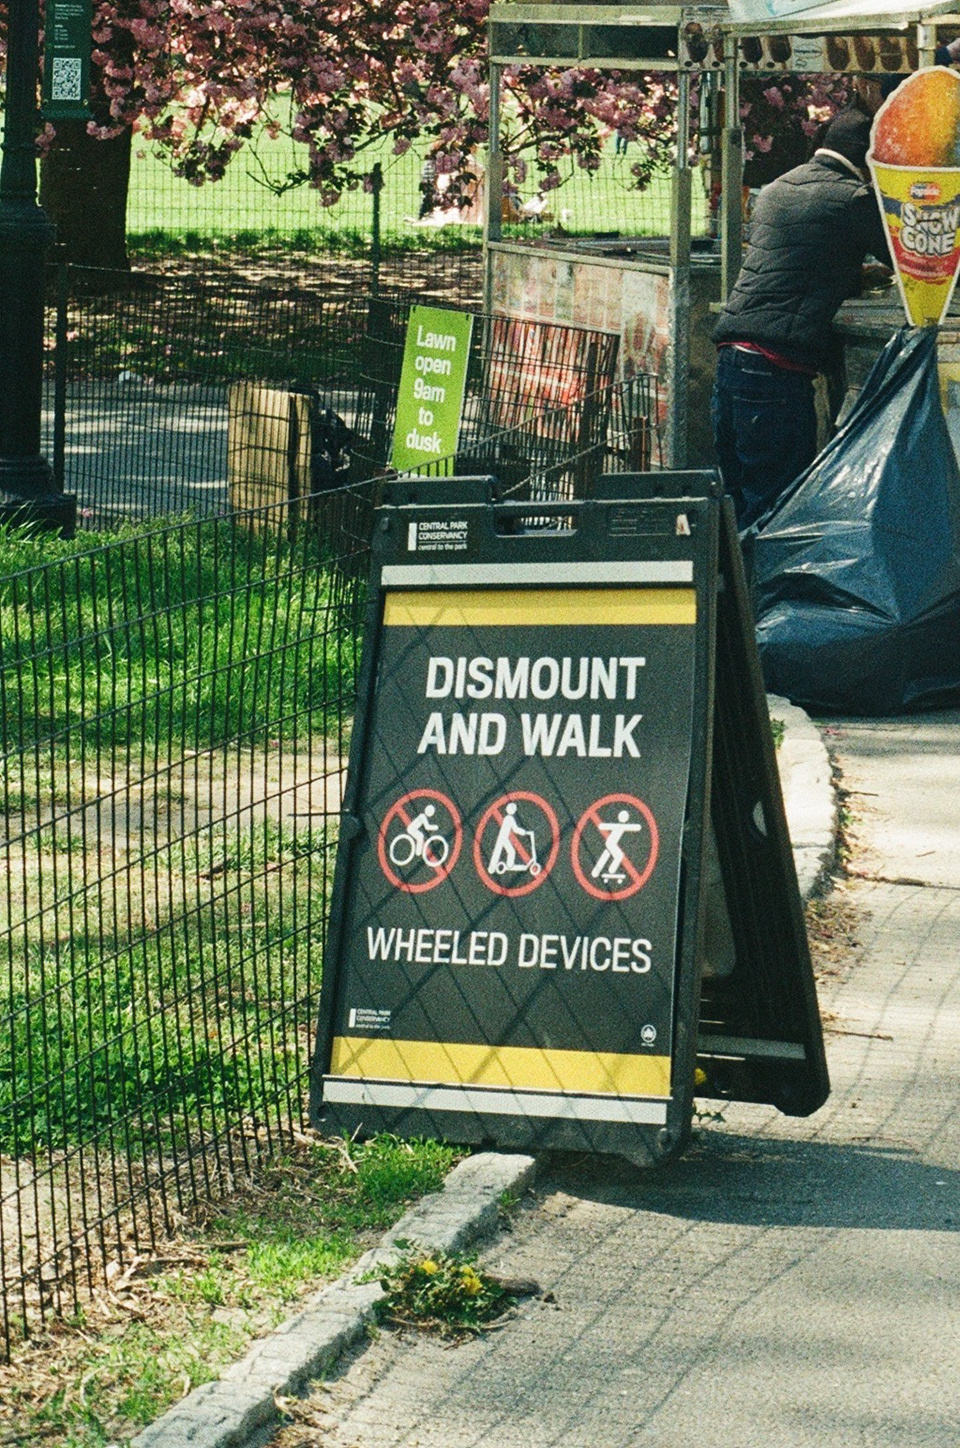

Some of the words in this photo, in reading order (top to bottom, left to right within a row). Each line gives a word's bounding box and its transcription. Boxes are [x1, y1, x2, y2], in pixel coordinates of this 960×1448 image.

[901, 225, 955, 255] CONE
[416, 325, 456, 352] Lawn
[414, 355, 452, 376] open
[413, 377, 446, 403] 9am
[418, 406, 434, 426] to
[406, 428, 442, 454] dusk
[418, 531, 468, 540] CONSERVANCY
[419, 522, 449, 531] CENTRAL
[450, 521, 469, 530] PARK
[425, 656, 645, 700] DISMOUNT
[417, 712, 507, 755] AND
[520, 713, 643, 758] WALK
[367, 926, 508, 967] WHEELED
[518, 933, 652, 974] DEVICES
